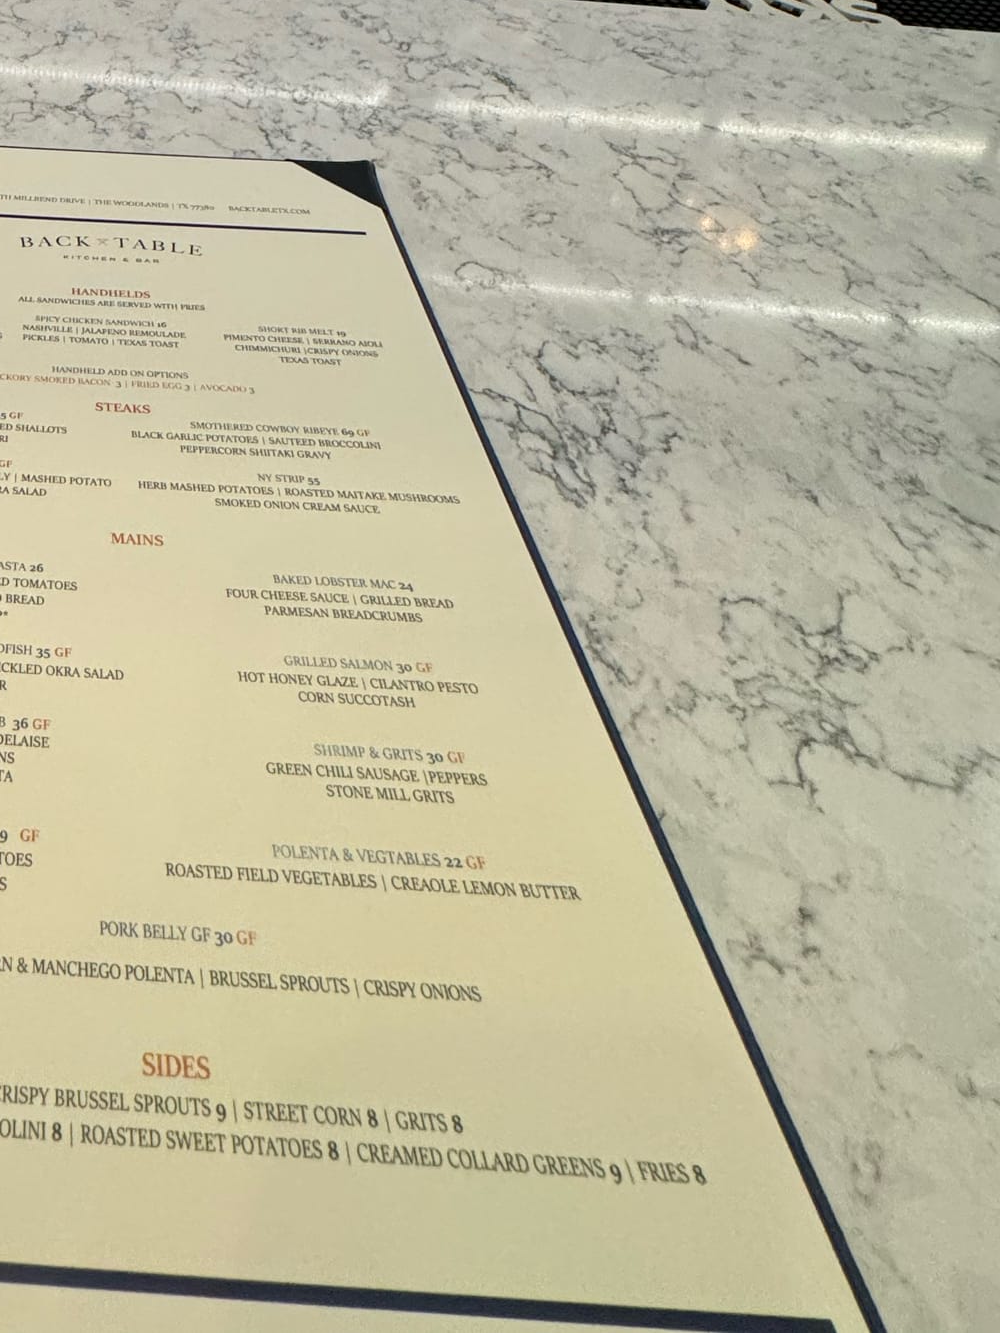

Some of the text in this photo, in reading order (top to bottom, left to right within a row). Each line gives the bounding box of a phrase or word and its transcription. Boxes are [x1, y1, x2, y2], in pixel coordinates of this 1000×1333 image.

[19, 235, 202, 256] BACK TABLE
[62, 254, 116, 262] KITCHEN
[71, 287, 151, 299] HANDHELDS
[17, 295, 206, 311] ALL SANDWICHES ARE SERVED WITH FRIES
[35, 314, 61, 323] SPICY
[61, 316, 103, 325] CHICKEN
[105, 318, 155, 328] SANDWICH
[94, 401, 151, 414] STEAKS
[256, 473, 321, 486] NY STRIP 55
[110, 531, 164, 547] MAINS
[29, 562, 44, 573] 26
[272, 573, 414, 593] BAKED LOBSTER MAC 24
[19, 828, 40, 842] GF
[142, 1052, 211, 1081] SIDES
[54, 1088, 130, 1112] BRUSSEL
[133, 1093, 212, 1118] SPROUTS
[215, 1103, 227, 1123] 9
[243, 1100, 308, 1125] STREET
[313, 1105, 363, 1127] CORN
[366, 1108, 379, 1128] 8
[394, 1110, 449, 1134] GRITS
[451, 1114, 464, 1134] 8
